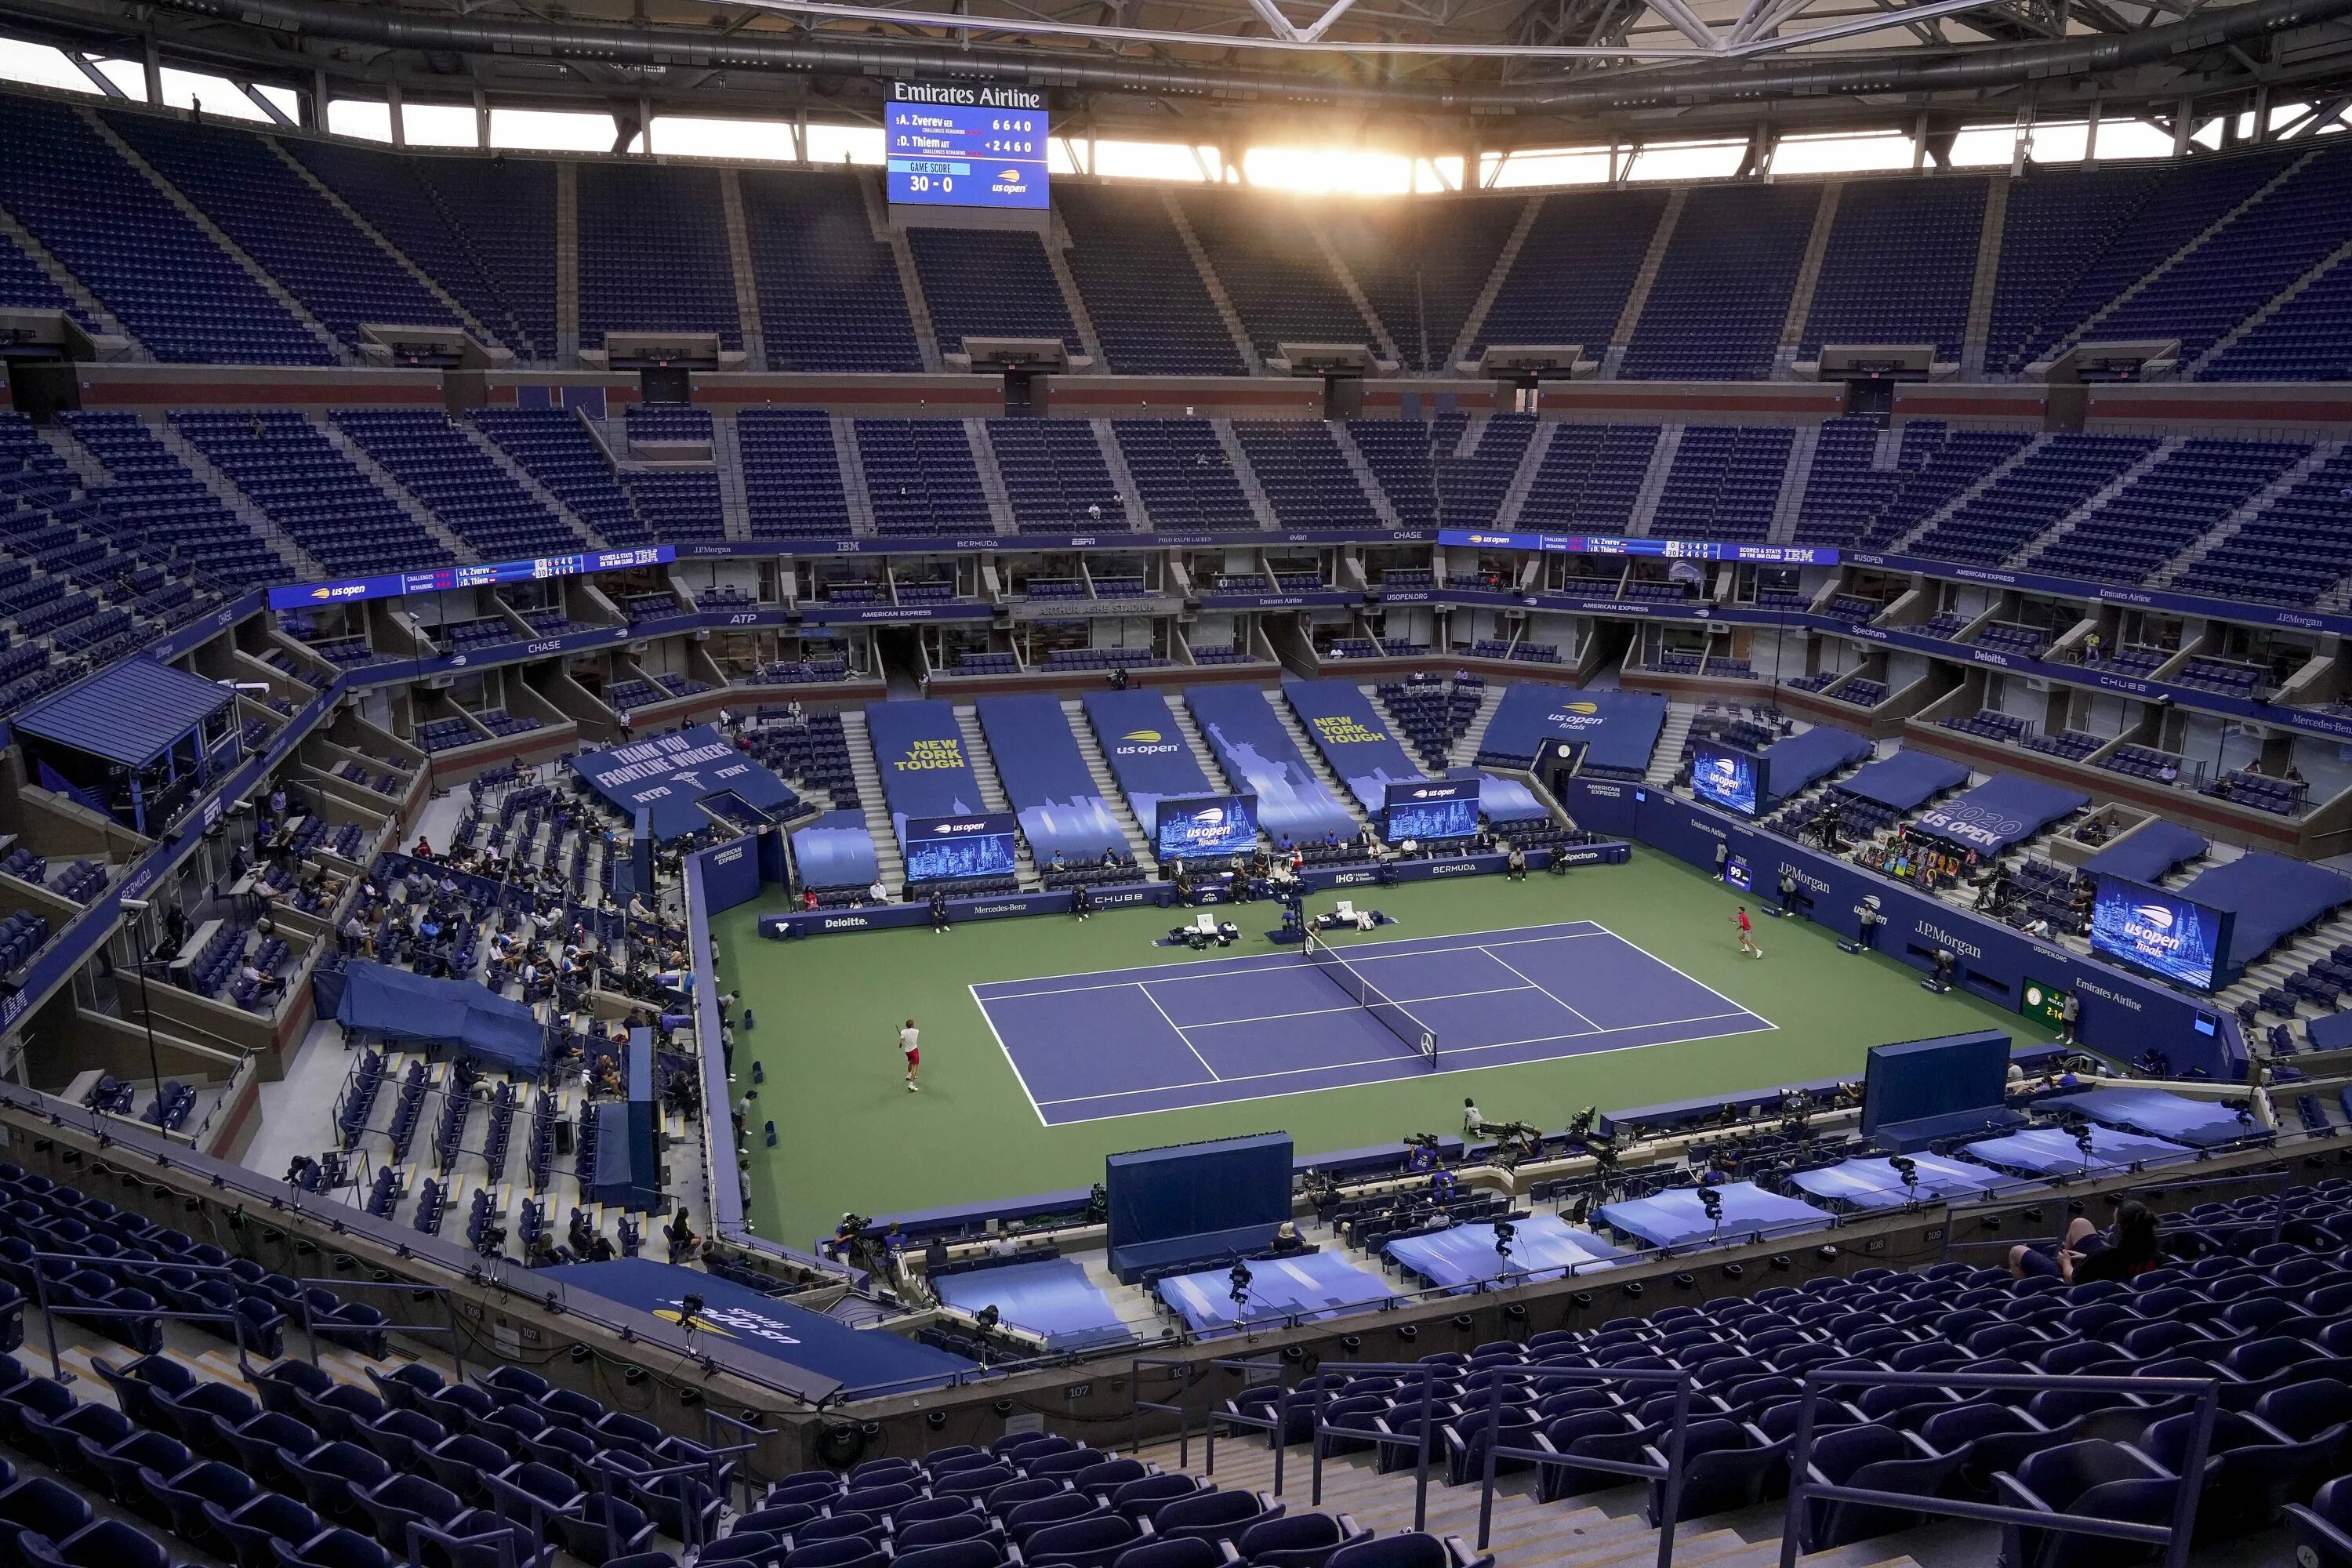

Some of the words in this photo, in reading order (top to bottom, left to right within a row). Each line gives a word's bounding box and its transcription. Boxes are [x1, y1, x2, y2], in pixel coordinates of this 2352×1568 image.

[895, 82, 974, 103] Emirates
[980, 88, 1040, 108] Airline
[900, 114, 909, 125] A.
[912, 115, 942, 127] Zverev
[993, 119, 1000, 130] 6
[1004, 120, 1010, 130] 6
[1014, 121, 1021, 131] 4
[1024, 121, 1031, 132] 0
[900, 136, 909, 147] D.
[912, 136, 940, 148] Thiem
[993, 140, 1000, 151] 2
[1004, 141, 1011, 151] 4
[1014, 141, 1021, 151] 6
[1024, 142, 1032, 152] 0
[910, 162, 928, 172] GAME
[931, 163, 951, 172] SCORE
[910, 176, 928, 191] 30
[942, 177, 953, 192] 0
[1004, 184, 1025, 194] open
[693, 546, 731, 554] J.P.Morgan
[837, 541, 859, 551] IBM
[635, 549, 658, 564] IBM
[1784, 548, 1814, 562] IBM
[1853, 554, 1883, 564] #USOPEN
[407, 573, 434, 582] CHALLENGES
[470, 567, 490, 575] Zverev
[1956, 569, 1986, 579] AMERICAN
[1987, 573, 2015, 583] EXPRESS
[332, 586, 342, 596] us
[343, 584, 365, 597] open
[2100, 590, 2128, 599] Emirates
[2128, 593, 2151, 603] Airline
[1039, 605, 1079, 615] ARTHUR
[1083, 605, 1109, 615] ASHE
[1112, 603, 1155, 613] STADIUM
[1583, 602, 1617, 612] AMERICAN
[1619, 604, 1649, 612] EXPRESS
[219, 609, 232, 626] CHASE
[730, 614, 757, 624] ATP
[2277, 613, 2322, 627] J.P.Morgan
[1853, 626, 1885, 639] Spectrum
[528, 639, 561, 654] CHASE
[1975, 650, 2008, 666] Deloitte.
[2101, 677, 2146, 691] CHUBB
[1313, 717, 1352, 727] NEW
[1566, 716, 1603, 725] open
[2292, 714, 2352, 734] Mercedes-Ben
[1317, 724, 1369, 735] YORK
[914, 739, 956, 750] NEW
[1324, 733, 1386, 744] TOUGH
[611, 743, 663, 764] THANK
[656, 735, 690, 753] YOU
[906, 750, 962, 760] YORK
[1138, 745, 1178, 754] open
[596, 757, 676, 788] FRONTLINE
[668, 742, 733, 767] WORKERS
[714, 764, 750, 779] FDNY
[894, 759, 964, 771] TOUGH
[1710, 773, 1719, 782] us
[1719, 776, 1739, 789] open
[632, 786, 673, 803] NYPD
[1716, 786, 1730, 797] finals
[1936, 800, 2022, 835] 2020
[964, 823, 984, 832] open
[1187, 829, 1200, 837] us
[1201, 826, 1231, 837] open
[1691, 819, 1711, 833] Emirates
[1710, 827, 1726, 839] Airline
[1922, 811, 1952, 827] US
[1947, 822, 2002, 847] OPEN
[1198, 837, 1219, 846] finals
[714, 847, 742, 861] AMERICAN
[718, 852, 742, 865] EXPRESS
[1433, 863, 1475, 873] BERMUDA
[1731, 866, 1741, 878] 99
[122, 868, 151, 900] BERMUDA
[1336, 873, 1353, 884] IHG
[1778, 862, 1830, 894] J.P.Morgan
[1095, 894, 1143, 903] CHUBB
[975, 903, 1027, 914] Mercedes-Benz
[825, 917, 868, 928] Deloitte.
[1915, 920, 1982, 960] J.P.Morgan
[2124, 922, 2142, 936] us
[2142, 929, 2180, 950] open
[2034, 946, 2067, 963] USOPEN.ORG
[2136, 941, 2163, 957] finals
[2076, 978, 2111, 999] Emirates
[2113, 993, 2142, 1011] Airline
[1, 988, 28, 1025] IBM
[2048, 996, 2064, 1007] ROLEX
[2046, 1007, 2063, 1020] 2:14
[726, 1308, 791, 1330] finals
[750, 1330, 801, 1344] us
[1069, 1385, 1089, 1398] 107
